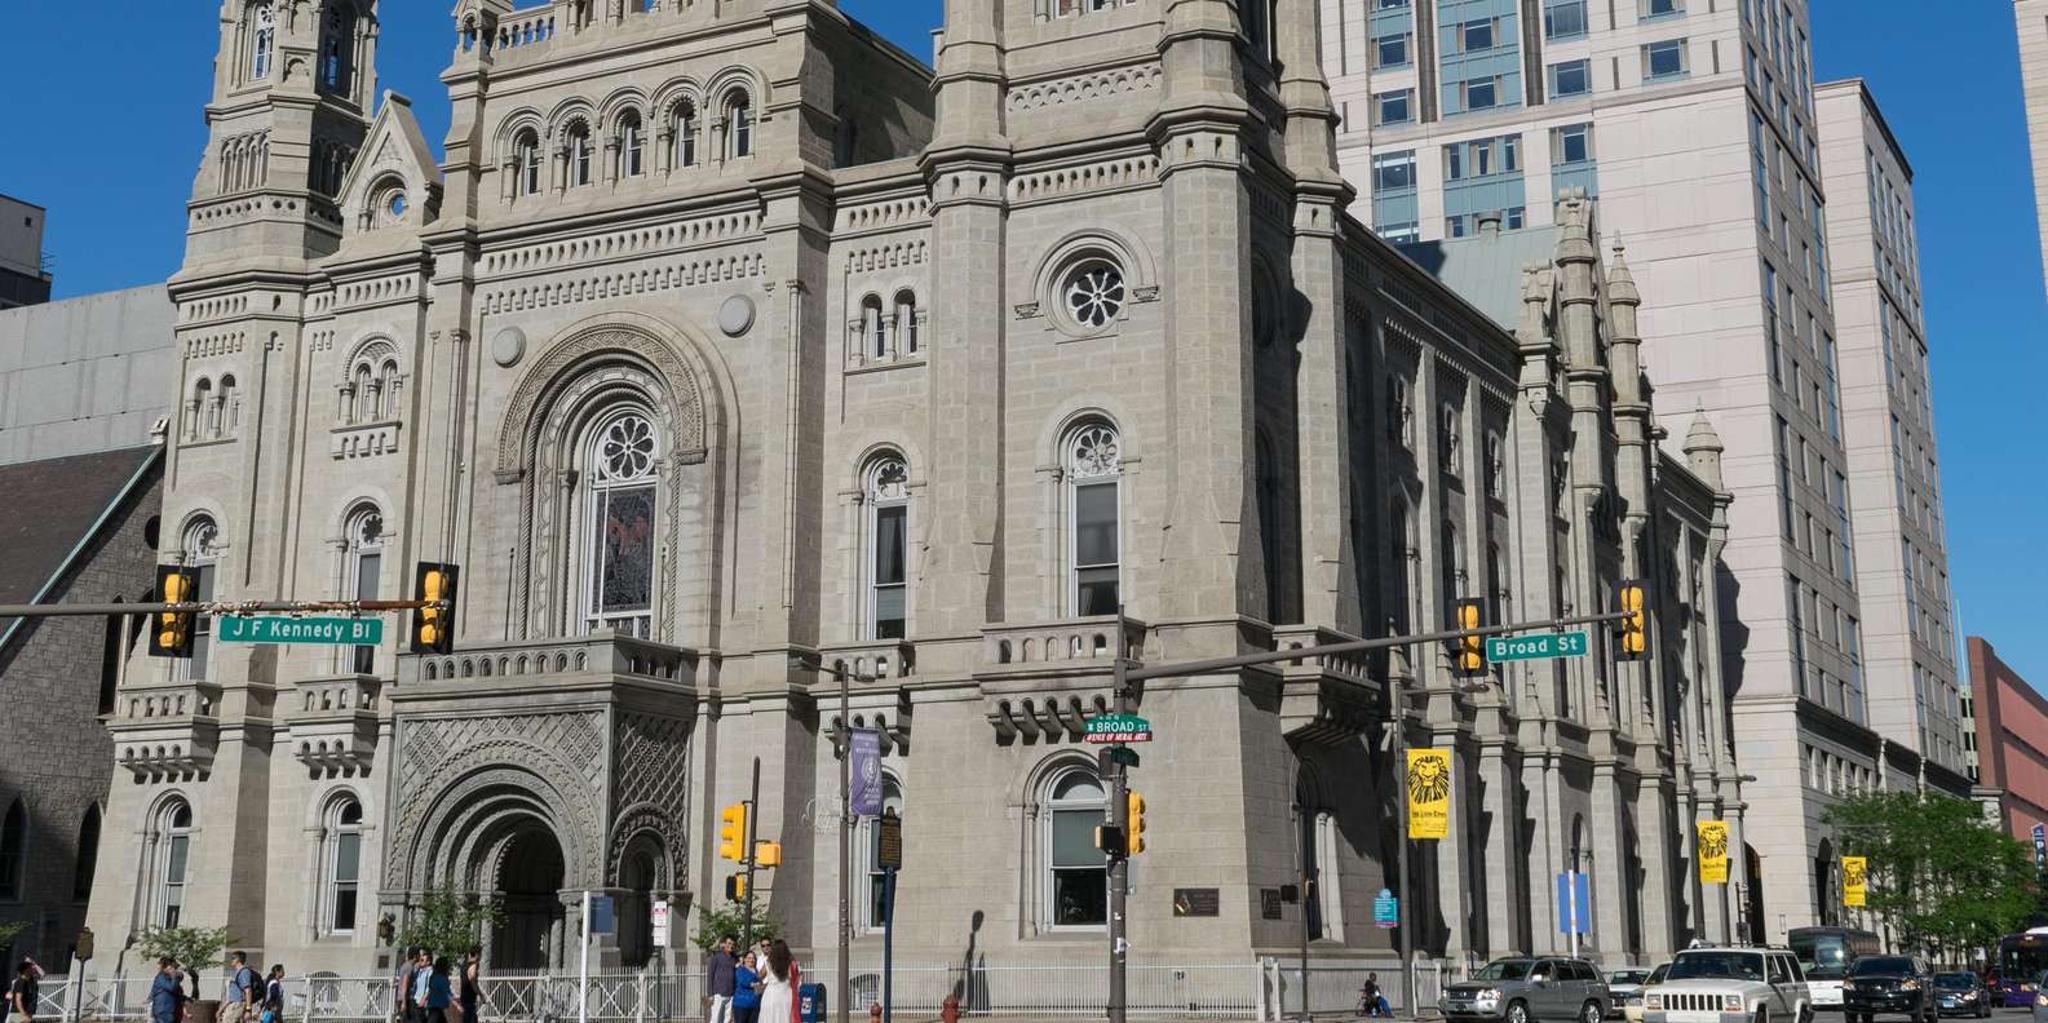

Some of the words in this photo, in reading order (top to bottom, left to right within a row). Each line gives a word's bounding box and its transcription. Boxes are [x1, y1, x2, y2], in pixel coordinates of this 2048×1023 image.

[233, 621, 243, 636] J
[252, 620, 263, 636] F
[270, 621, 344, 642] Kennedy
[1495, 638, 1548, 656] Broad
[1558, 636, 1578, 651] St
[1096, 721, 1134, 732] BROAD
